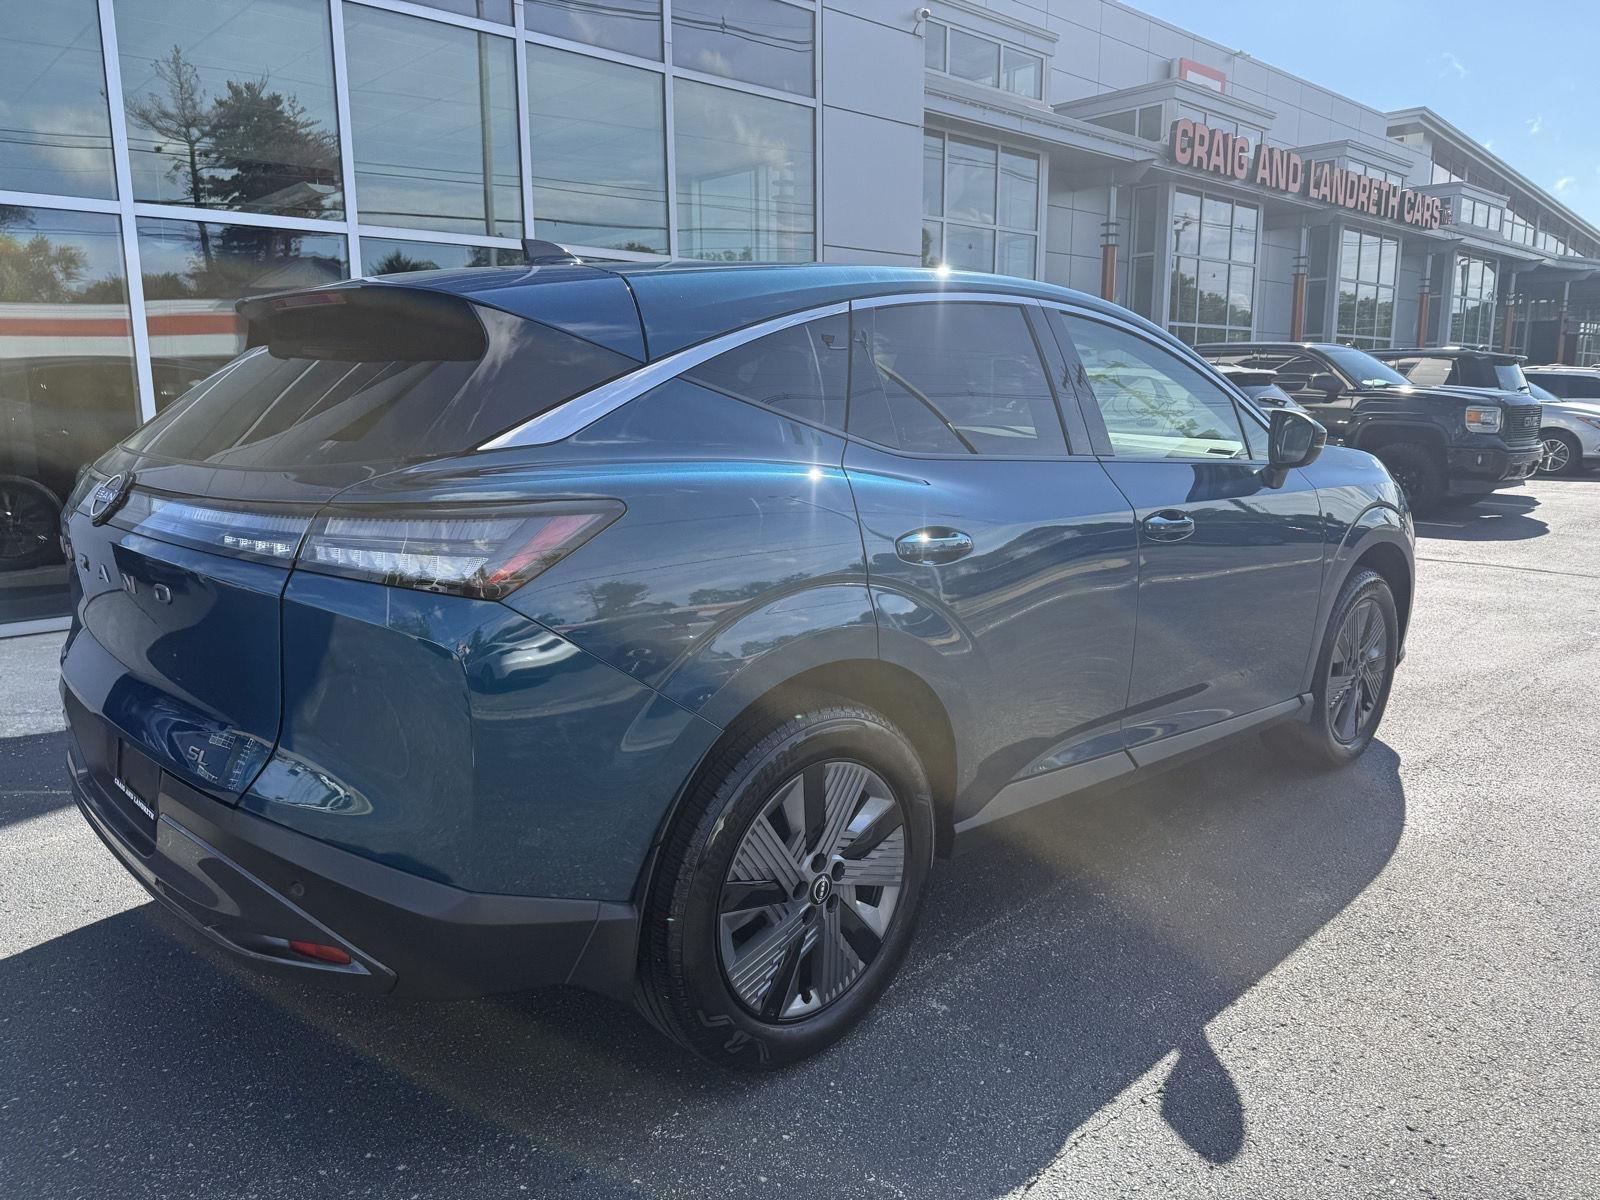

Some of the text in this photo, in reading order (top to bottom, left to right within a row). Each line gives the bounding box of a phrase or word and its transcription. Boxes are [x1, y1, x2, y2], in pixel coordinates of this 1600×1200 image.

[1175, 118, 1441, 230] CRAIG AND LANDRETH CARS
[187, 745, 208, 766] SL
